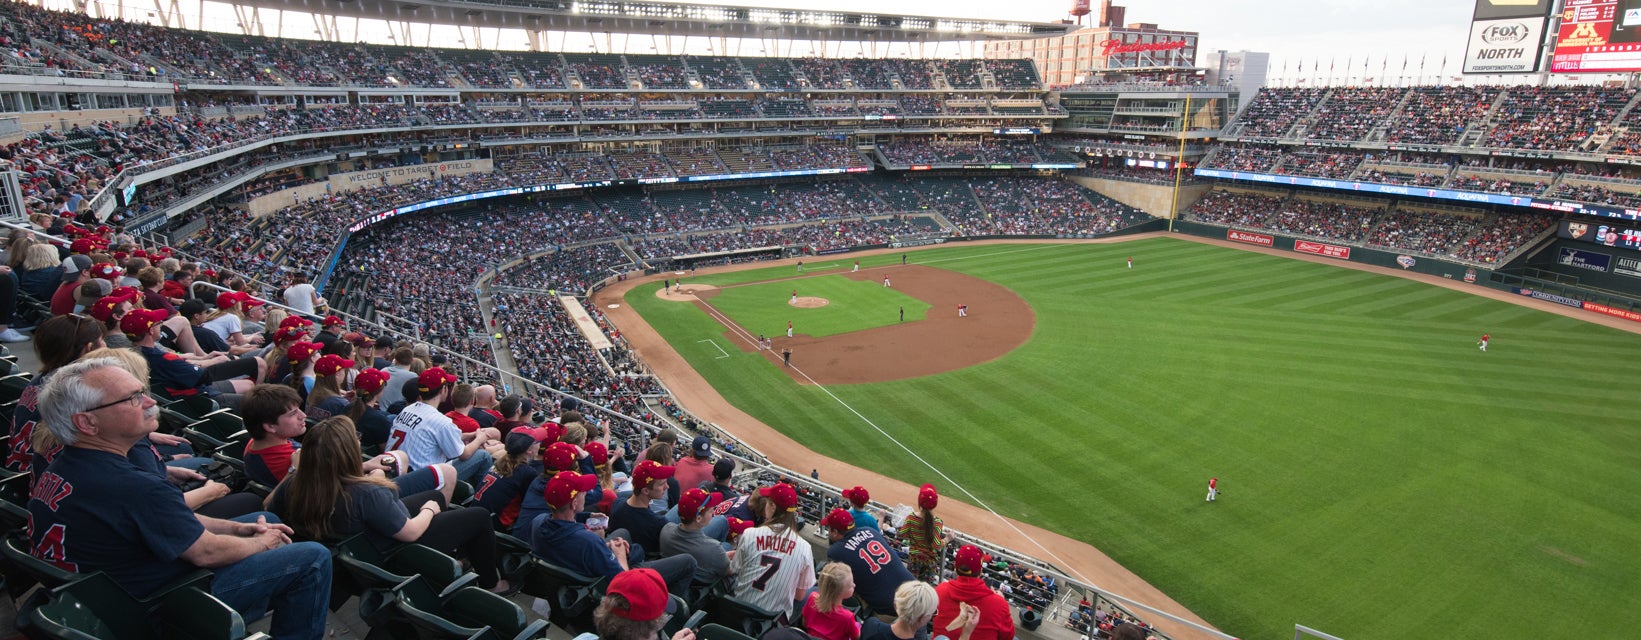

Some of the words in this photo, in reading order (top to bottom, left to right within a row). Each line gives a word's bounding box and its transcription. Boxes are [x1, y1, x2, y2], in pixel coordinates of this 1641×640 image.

[1491, 25, 1519, 37] FOX
[1477, 47, 1525, 60] NORTH
[349, 170, 391, 182] WELCOME
[393, 168, 405, 176] TO
[406, 165, 438, 176] TARGET
[447, 162, 472, 171] FIELD
[1456, 192, 1490, 203] AQUAFINA
[1572, 261, 1605, 271] HARTFORD
[1584, 303, 1608, 313] GETTING
[1608, 307, 1624, 317] MORE
[391, 428, 408, 451] 7
[475, 473, 498, 501] 7
[756, 535, 797, 556] MAUER
[844, 528, 875, 551] VARGAS
[858, 539, 892, 575] 19
[751, 553, 782, 592] 7
